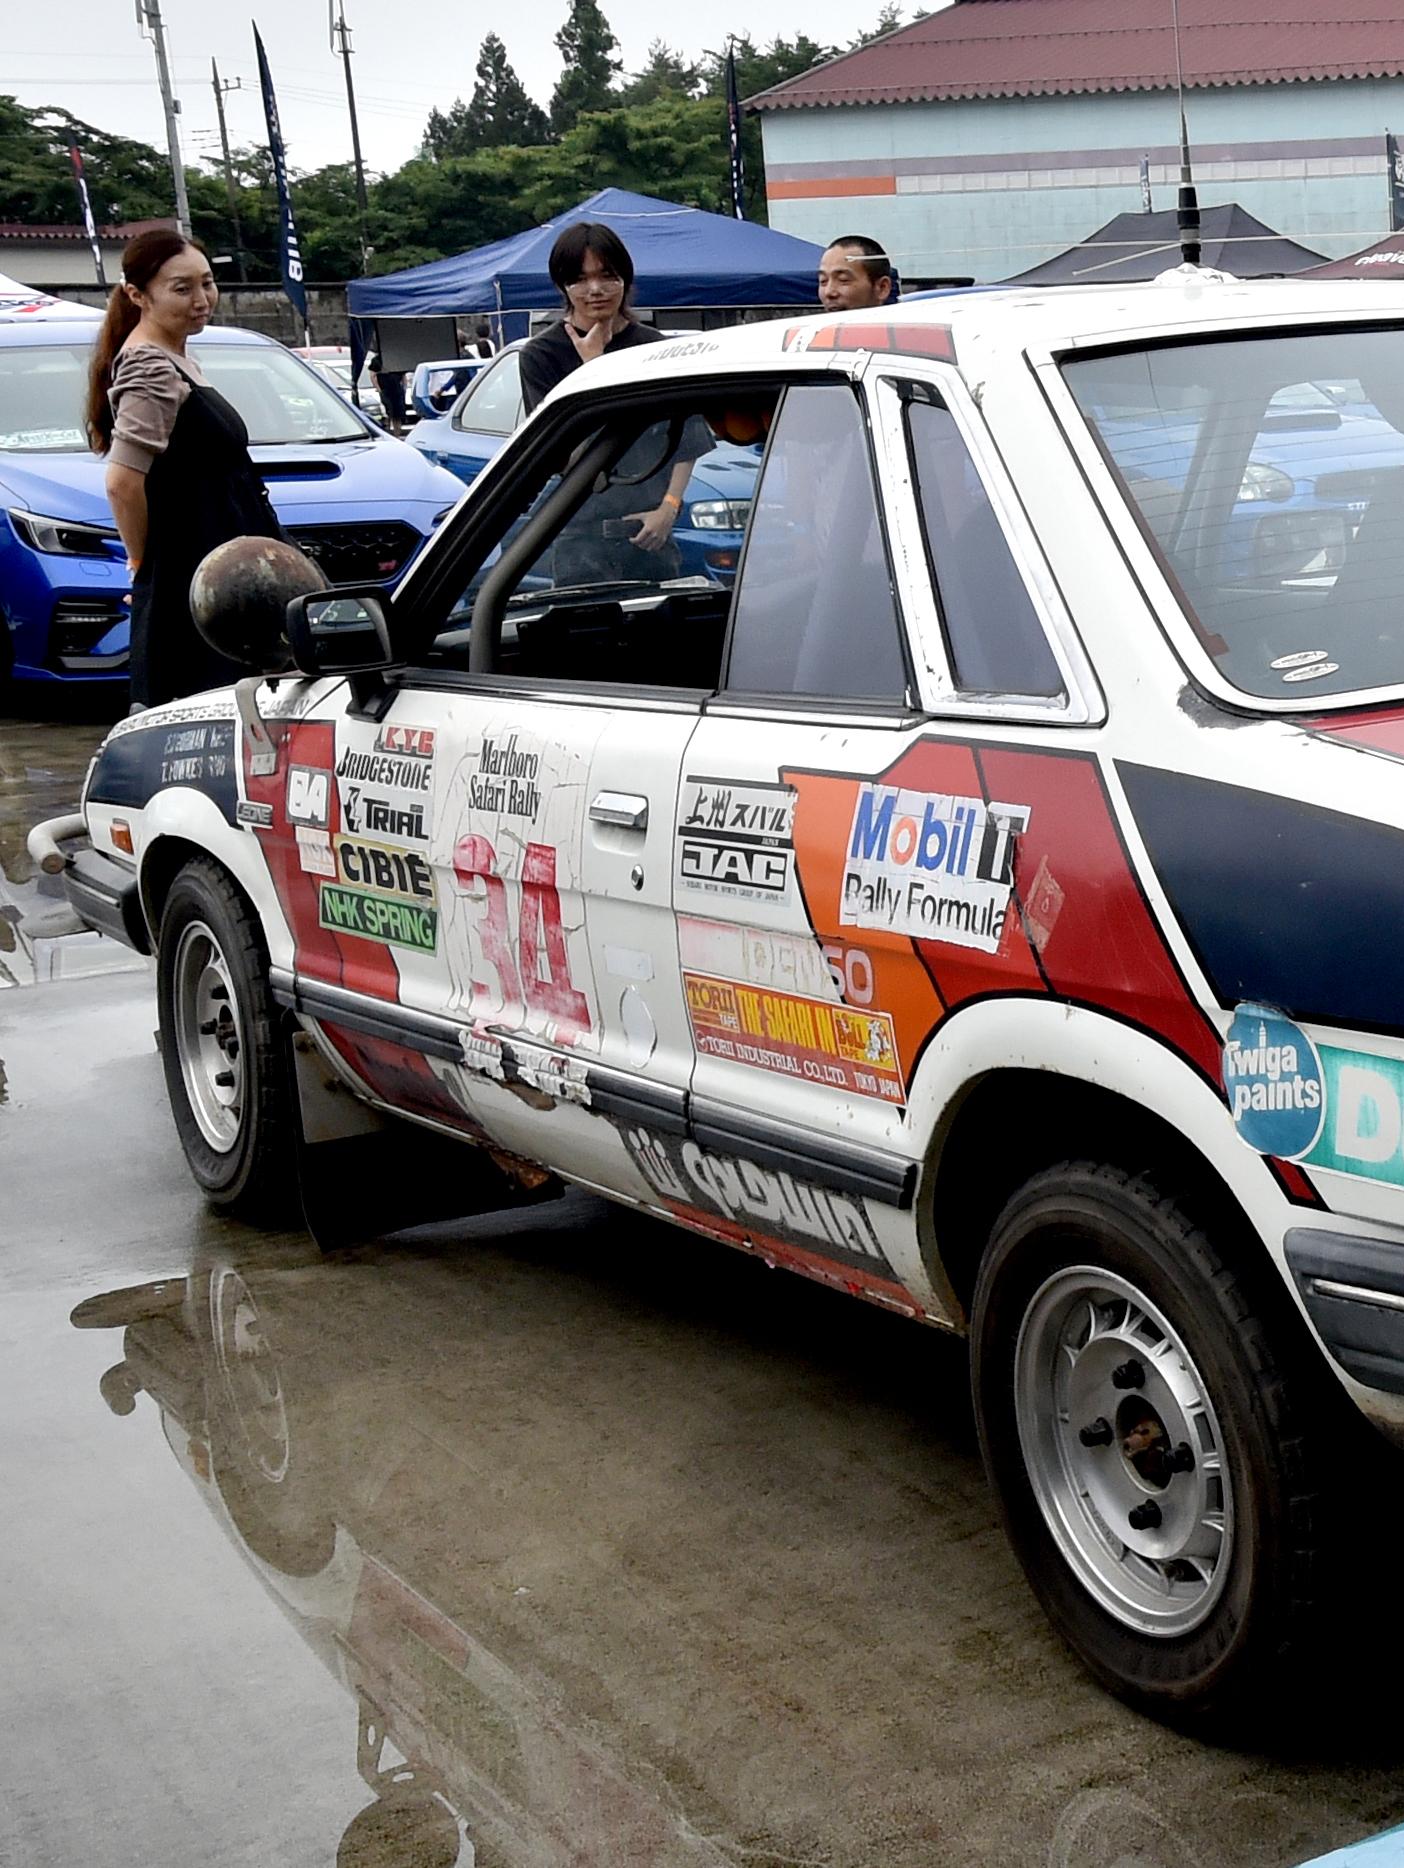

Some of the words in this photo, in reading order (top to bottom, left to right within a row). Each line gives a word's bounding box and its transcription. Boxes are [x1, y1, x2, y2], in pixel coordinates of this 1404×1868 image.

[385, 727, 434, 754] KYB
[479, 734, 538, 779] Marlboro
[336, 746, 432, 790] BRIDGESTONE
[363, 798, 429, 840] TRIAL
[468, 775, 506, 813] Safari
[507, 780, 541, 825] Rally
[685, 785, 787, 832] 上州スバル
[851, 791, 976, 876] Mobil
[682, 845, 787, 889] JAC
[324, 889, 363, 930] NHK
[363, 899, 434, 947] SPRING
[845, 873, 902, 925] Rally
[907, 881, 1006, 940] Formula
[686, 979, 735, 1014] TORII
[719, 1012, 738, 1030] TAPE
[735, 987, 764, 1037] THE
[763, 993, 817, 1050] SAFARI
[814, 1006, 837, 1056] IN
[705, 1036, 735, 1057] TORII
[736, 1042, 802, 1074] INDUSTRIAL
[1226, 1024, 1298, 1080] Twiga
[1233, 1076, 1322, 1121] paints
